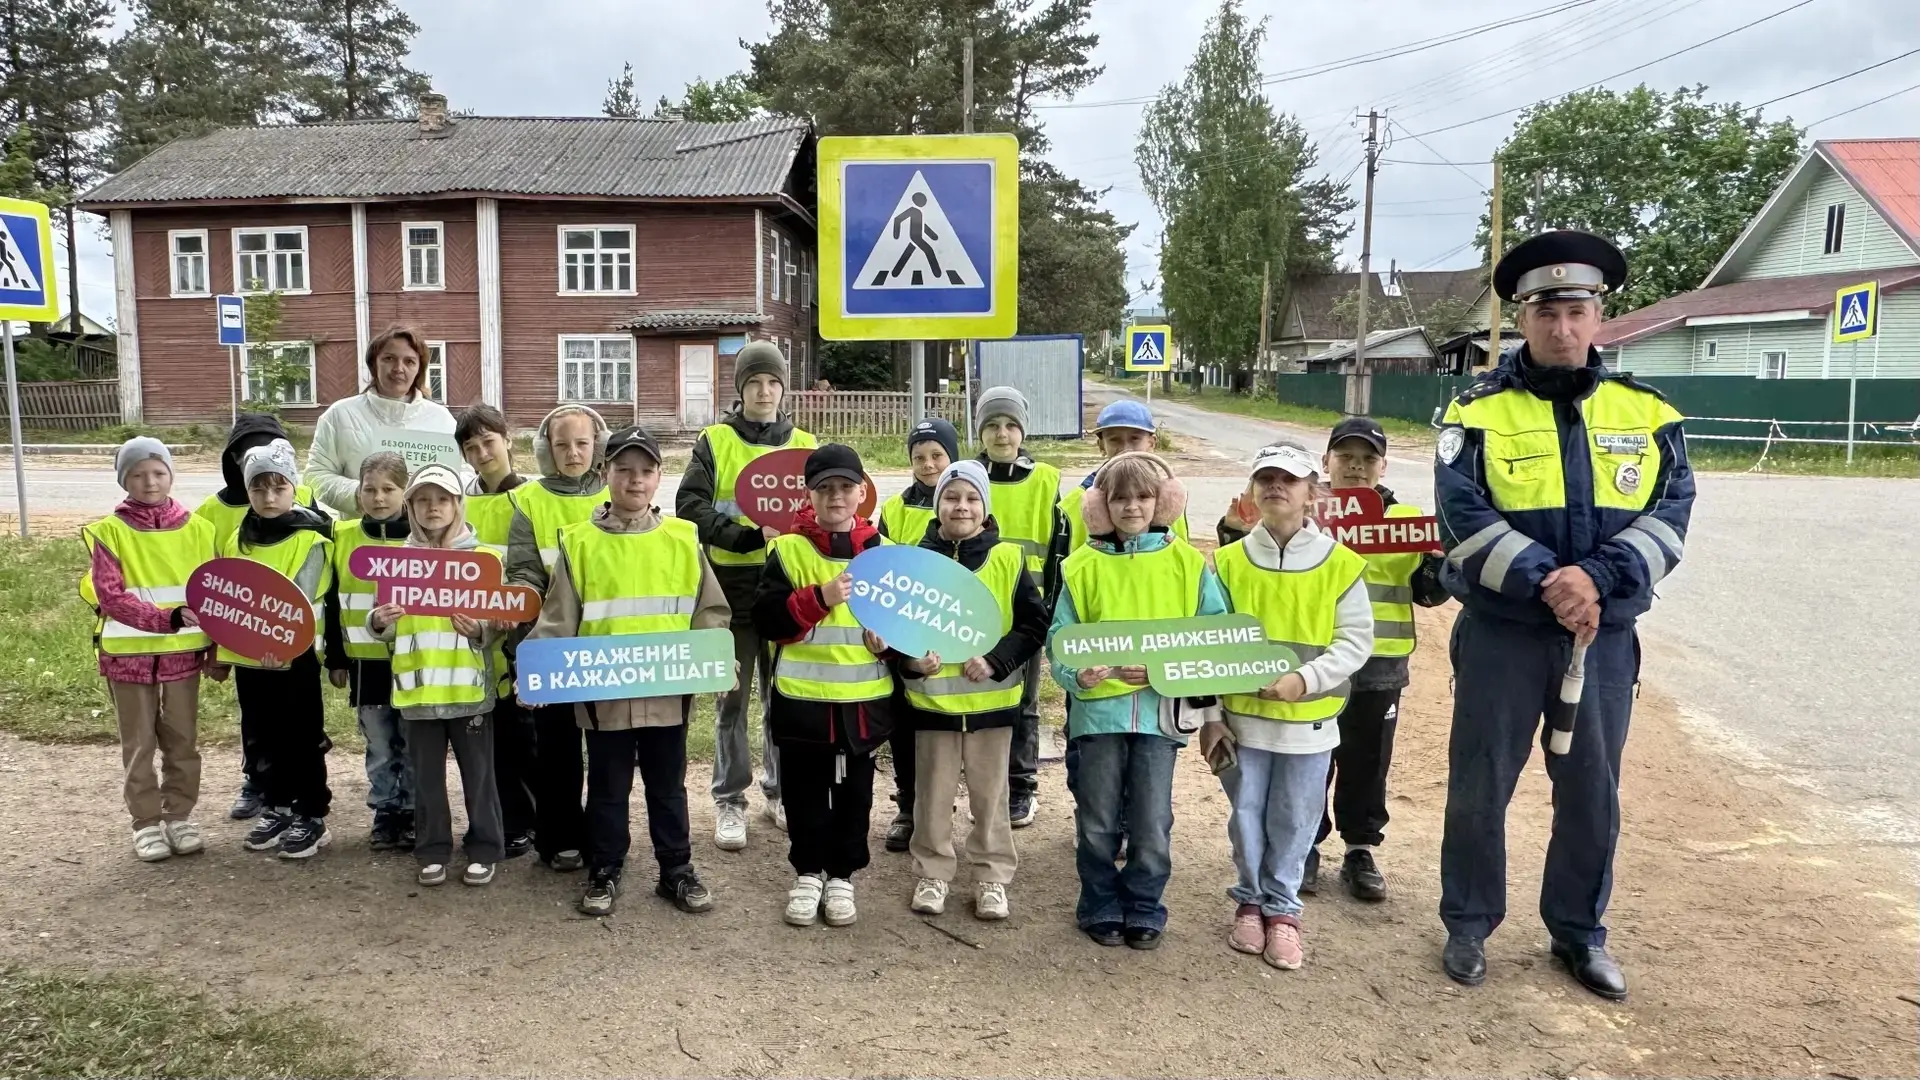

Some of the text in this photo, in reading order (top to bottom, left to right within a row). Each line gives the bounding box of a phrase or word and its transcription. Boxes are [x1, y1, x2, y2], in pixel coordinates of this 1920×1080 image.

[381, 439, 454, 453] БЕЗОПАСНОСТЬ
[400, 450, 437, 462] ЕТЕЙ
[750, 474, 806, 490] СО СВ
[757, 497, 783, 512] ПО
[1313, 496, 1364, 519] ГДА
[1322, 522, 1440, 545] АМЕТНЫ
[366, 557, 481, 581] ЖИВУ ПО
[201, 572, 305, 624] ЗНАЮ, КУДА
[391, 586, 526, 611] ПРАВИЛАМ
[879, 569, 962, 617] ДОРОГА
[199, 597, 296, 645] ДВИГАТЬСЯ
[853, 580, 987, 647] ЭТО ДИАЛОГ
[1062, 626, 1263, 655] НАЧНИ ДВИЖЕНИЕ
[563, 643, 692, 668] УВАЖЕНИЕ
[527, 660, 727, 691] В КАЖДОМ ШАГЕ
